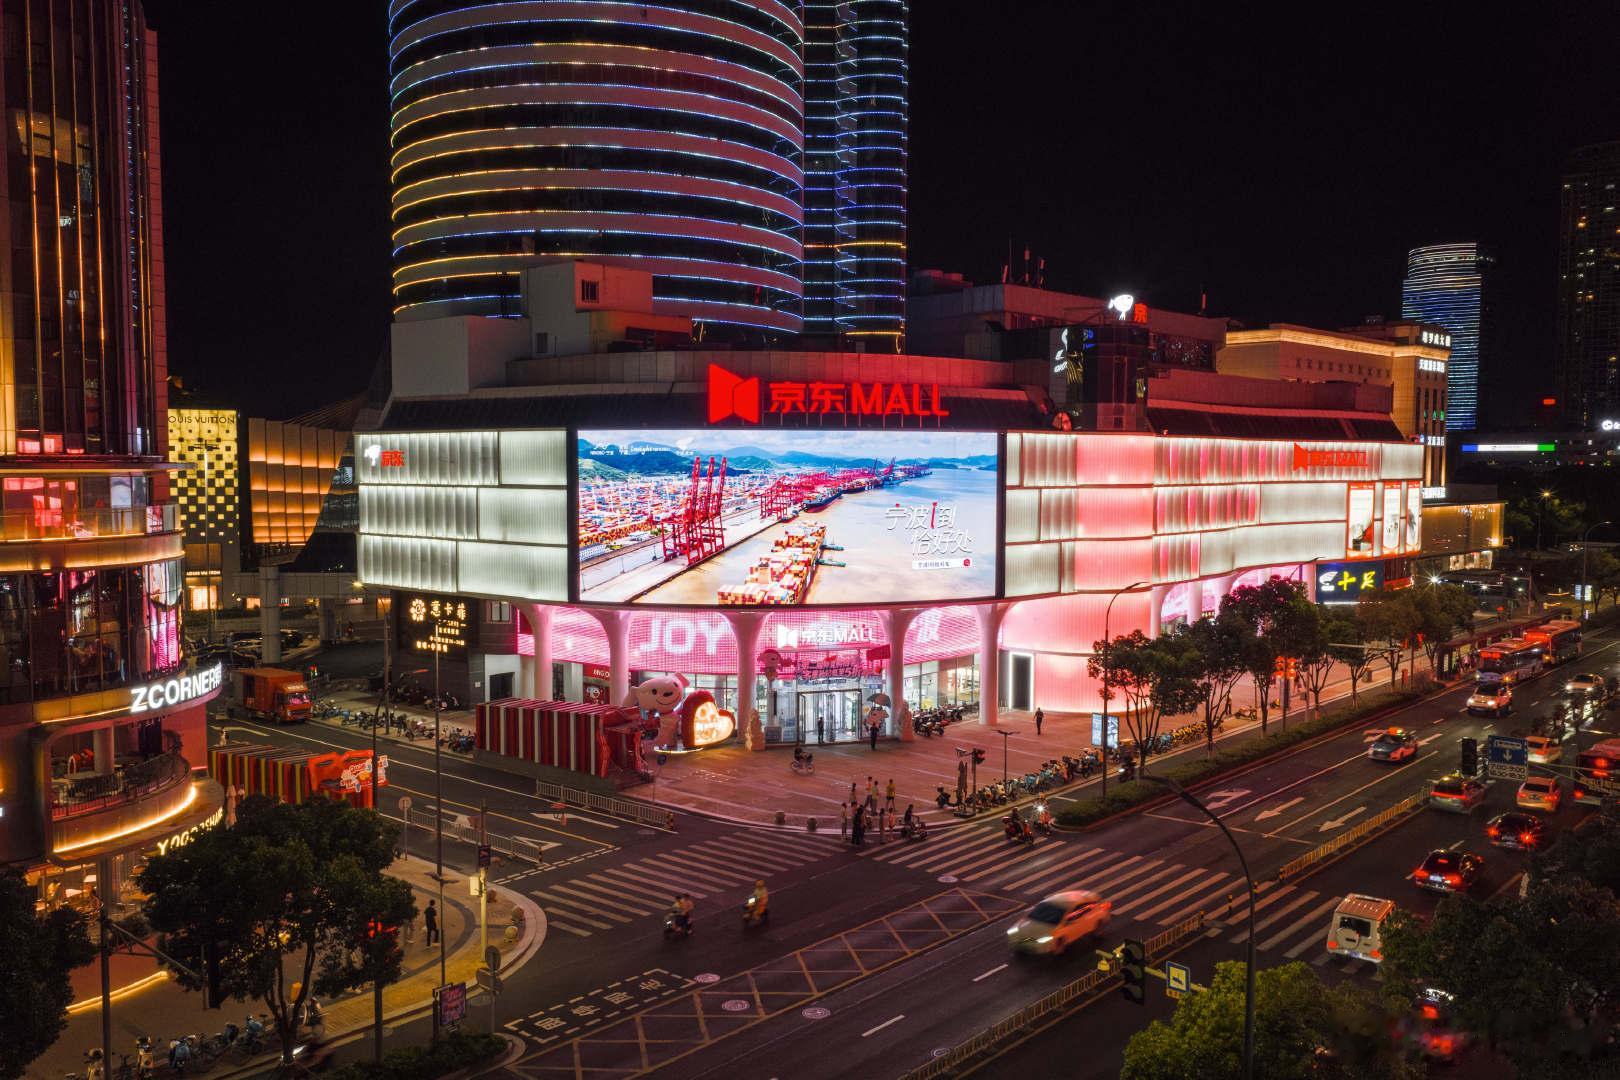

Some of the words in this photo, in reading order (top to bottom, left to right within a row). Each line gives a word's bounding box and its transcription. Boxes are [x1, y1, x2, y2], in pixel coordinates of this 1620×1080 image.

[769, 381, 949, 416] 京东MALL
[168, 415, 192, 424] OUIS
[194, 415, 235, 424] VUITTON
[911, 528, 973, 556] 恰好处
[1337, 570, 1376, 591] 十足
[638, 618, 729, 656] JOY
